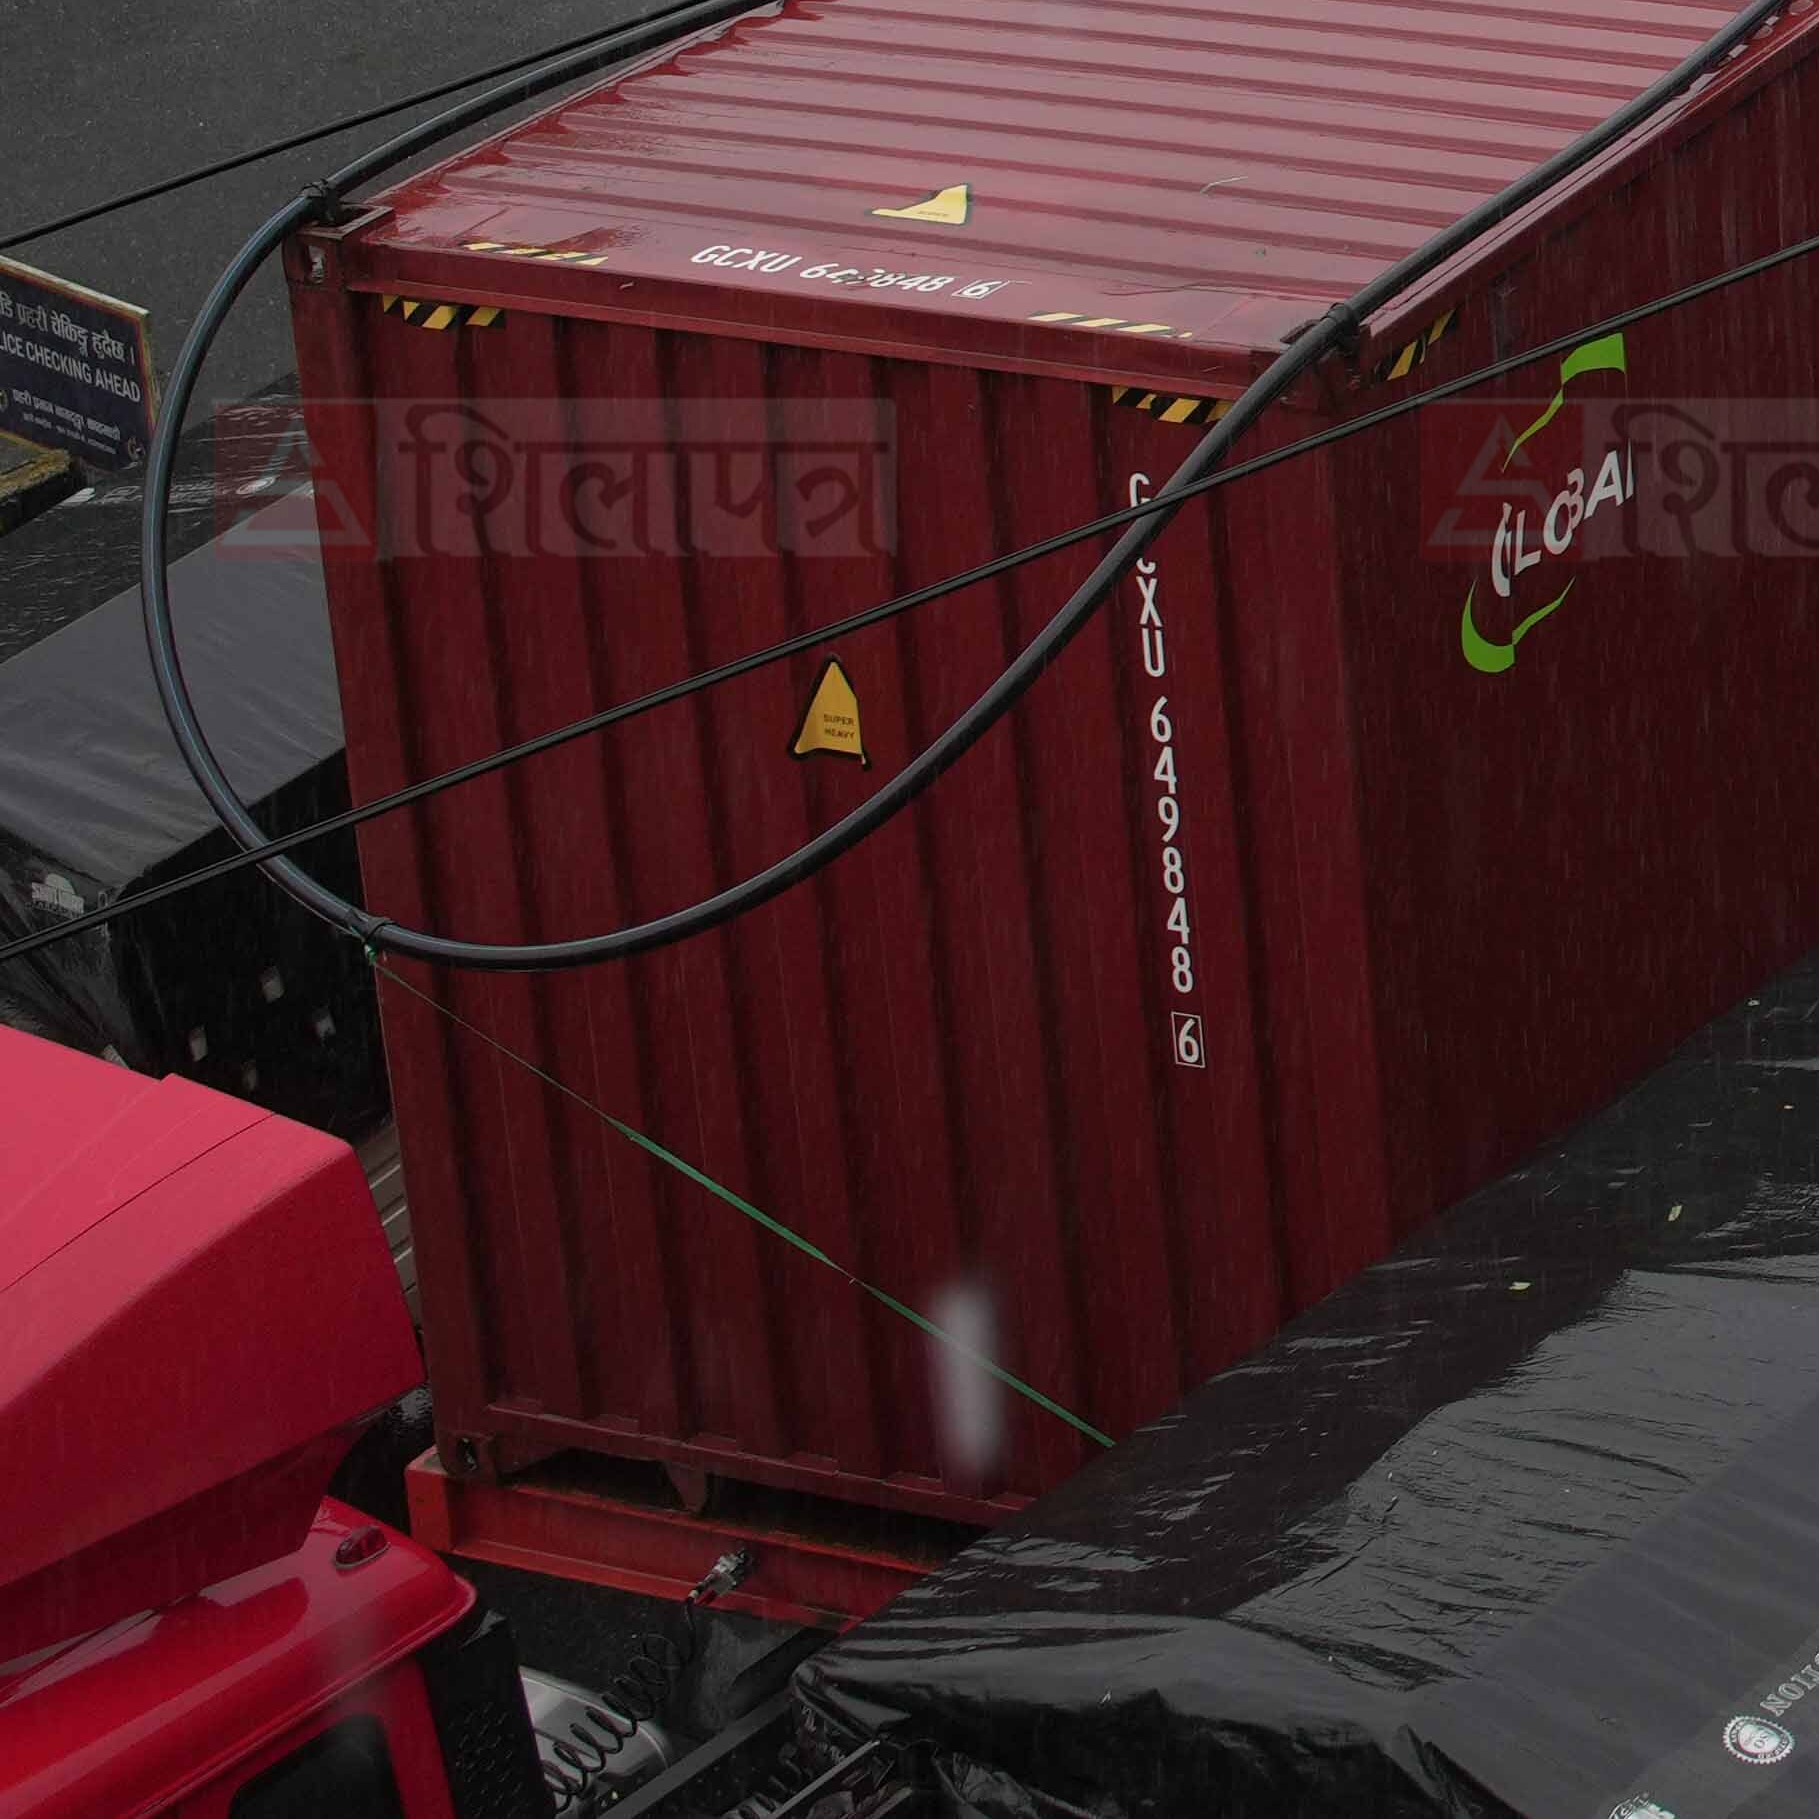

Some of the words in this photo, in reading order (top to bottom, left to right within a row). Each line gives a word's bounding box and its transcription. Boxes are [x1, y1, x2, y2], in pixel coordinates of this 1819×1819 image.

[691, 245, 802, 272] GCXU
[25, 341, 93, 384] CHECKING
[95, 367, 141, 404] AHEAD
[822, 713, 856, 728] SUPER
[823, 727, 856, 741] HEAVY
[1129, 472, 1166, 678] GXU
[1149, 695, 1194, 994] 649848
